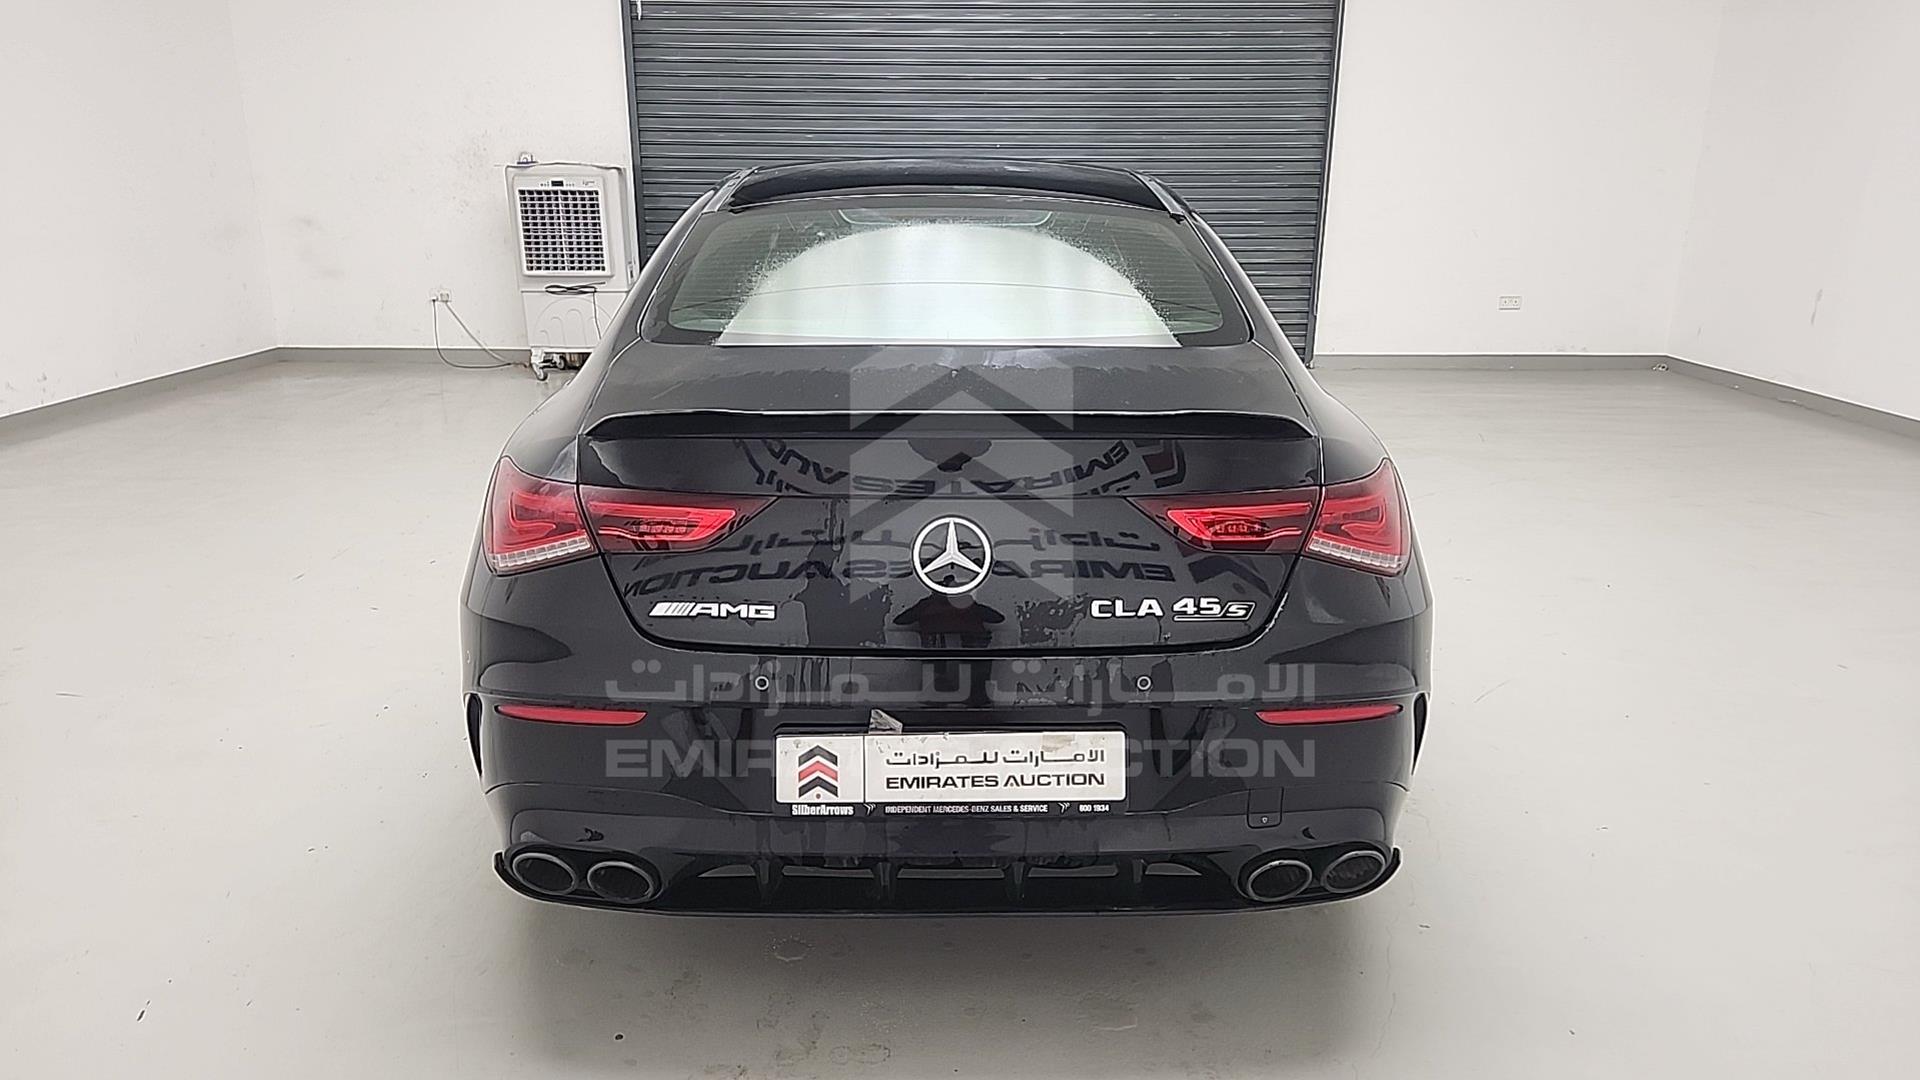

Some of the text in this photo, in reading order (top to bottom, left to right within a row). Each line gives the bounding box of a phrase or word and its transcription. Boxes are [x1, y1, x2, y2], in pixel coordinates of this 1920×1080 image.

[688, 602, 775, 619] AMG
[1090, 598, 1164, 617] CLA
[886, 773, 1105, 789] EMIRATES AUCTION
[791, 804, 854, 815] SilberArrows
[885, 805, 932, 814] INDEPENDENT
[990, 804, 1012, 813] SALES
[1013, 804, 1019, 813] &
[1020, 804, 1049, 813] SERVICE
